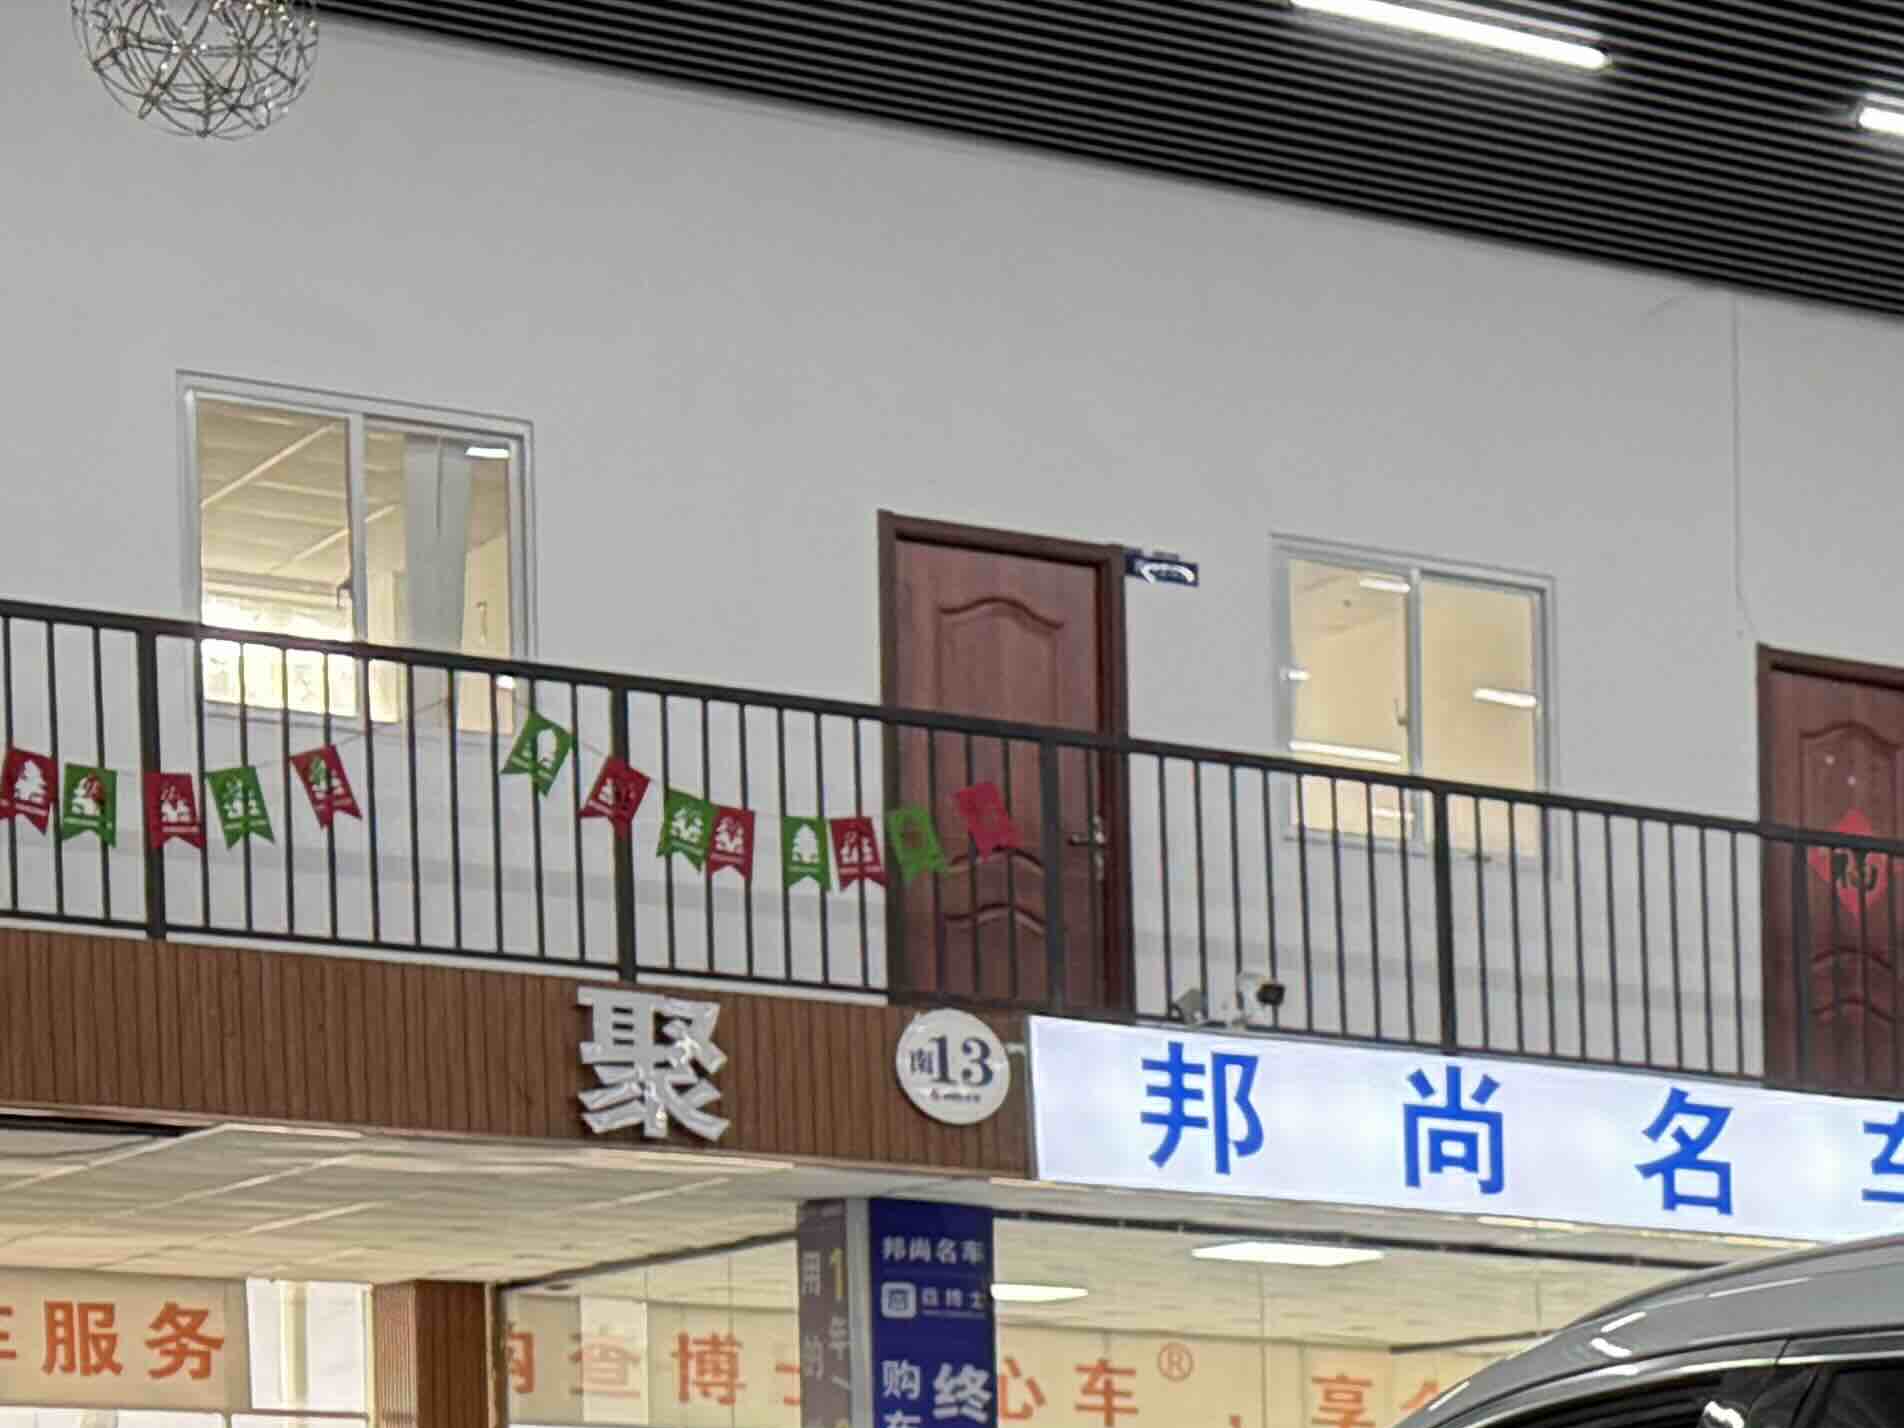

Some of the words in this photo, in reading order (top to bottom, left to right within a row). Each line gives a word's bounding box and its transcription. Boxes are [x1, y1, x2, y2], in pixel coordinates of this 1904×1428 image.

[577, 986, 731, 1142] 聚
[882, 1236, 985, 1264] 邦尚名车
